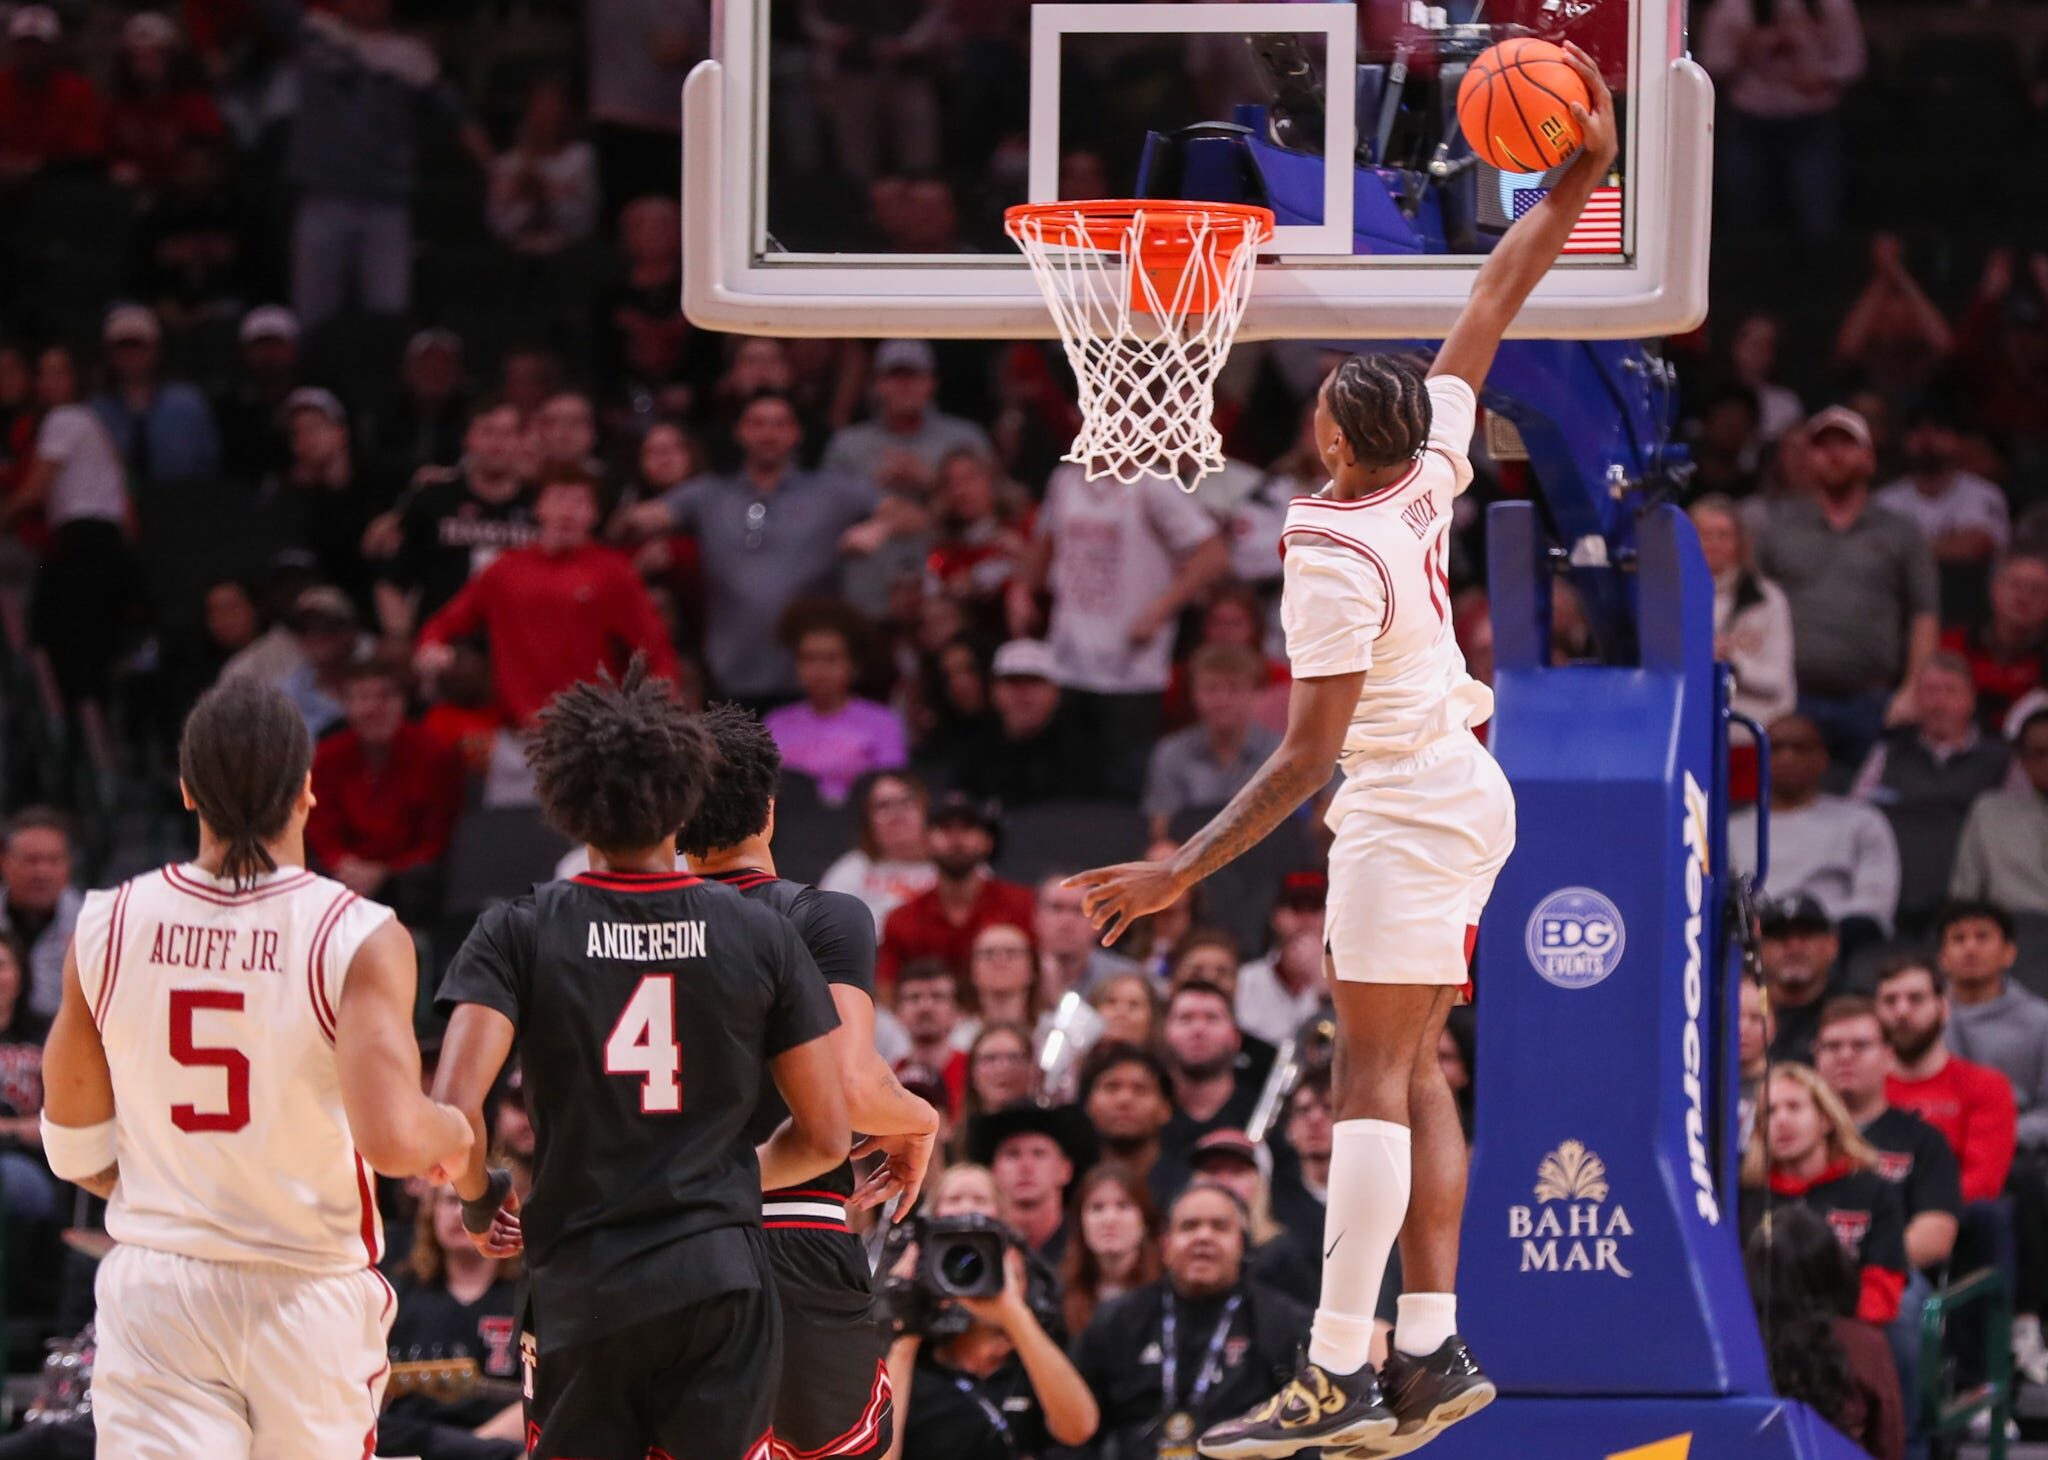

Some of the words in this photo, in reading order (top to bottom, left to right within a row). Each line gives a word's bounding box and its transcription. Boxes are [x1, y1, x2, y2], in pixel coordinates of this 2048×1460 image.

[1401, 489, 1437, 540] KNOX
[149, 921, 236, 971] ACUFF
[241, 928, 283, 973] JR.
[586, 920, 707, 961] ANDERSON
[1540, 916, 1614, 951] BDG
[1545, 955, 1605, 977] EVENTS
[169, 989, 251, 1134] 5
[604, 973, 682, 1114] 4
[1508, 1204, 1634, 1238] BAHA
[1520, 1238, 1633, 1279] MAR
